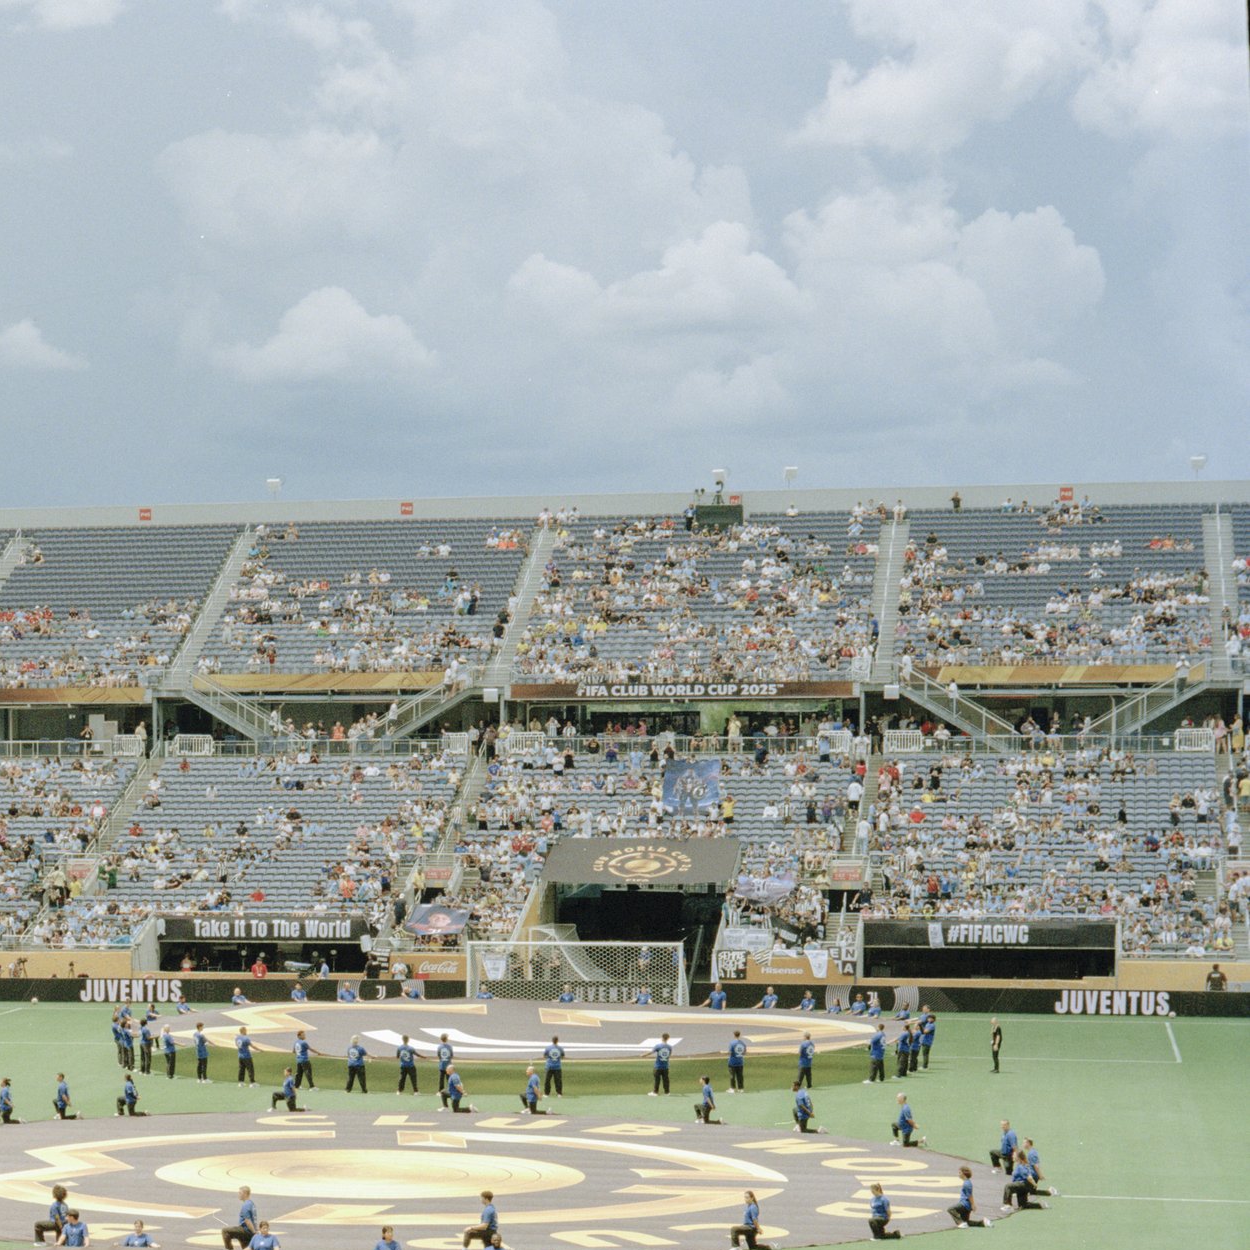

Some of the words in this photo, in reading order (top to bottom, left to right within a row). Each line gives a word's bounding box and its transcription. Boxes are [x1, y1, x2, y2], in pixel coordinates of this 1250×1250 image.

[577, 683, 607, 697] FIFA
[611, 684, 648, 697] CLUB
[650, 684, 702, 697] WORLD
[707, 683, 738, 696] CUP
[610, 845, 667, 856] WORLD
[193, 918, 230, 938] Take
[234, 919, 246, 938] It
[251, 919, 268, 938] To
[273, 919, 300, 938] The
[305, 919, 351, 938] World
[947, 924, 1029, 944] #FIFACWC
[761, 966, 804, 975] Hisense
[80, 979, 183, 1003] JUVENTUS
[1055, 990, 1170, 1016] JUVENTUS
[255, 1115, 682, 1136] CLUB
[732, 1138, 963, 1220] WORLD
